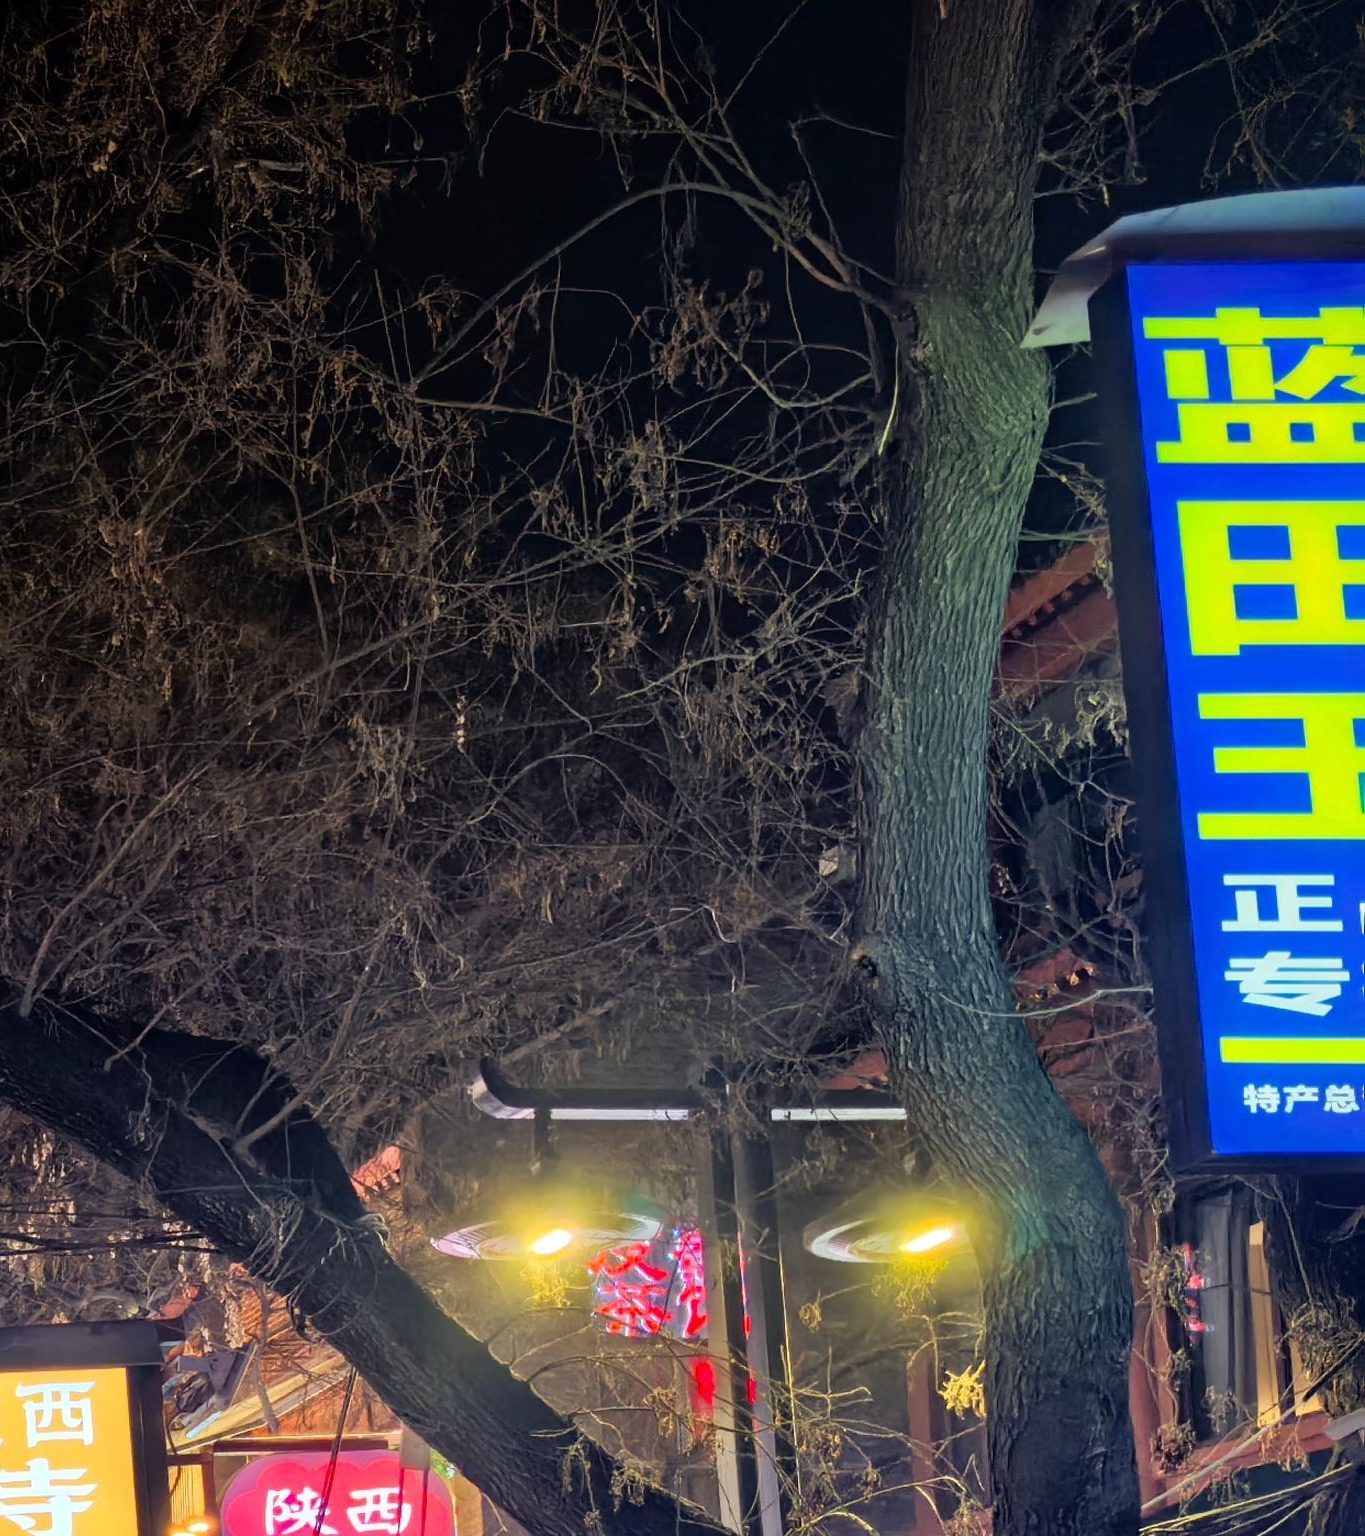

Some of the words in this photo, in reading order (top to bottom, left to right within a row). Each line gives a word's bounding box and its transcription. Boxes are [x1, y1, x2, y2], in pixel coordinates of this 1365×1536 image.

[1221, 873, 1365, 932] 正
[1224, 950, 1365, 1017] 专
[1242, 1083, 1365, 1114] 特产总
[264, 1486, 413, 1536] 陕西
